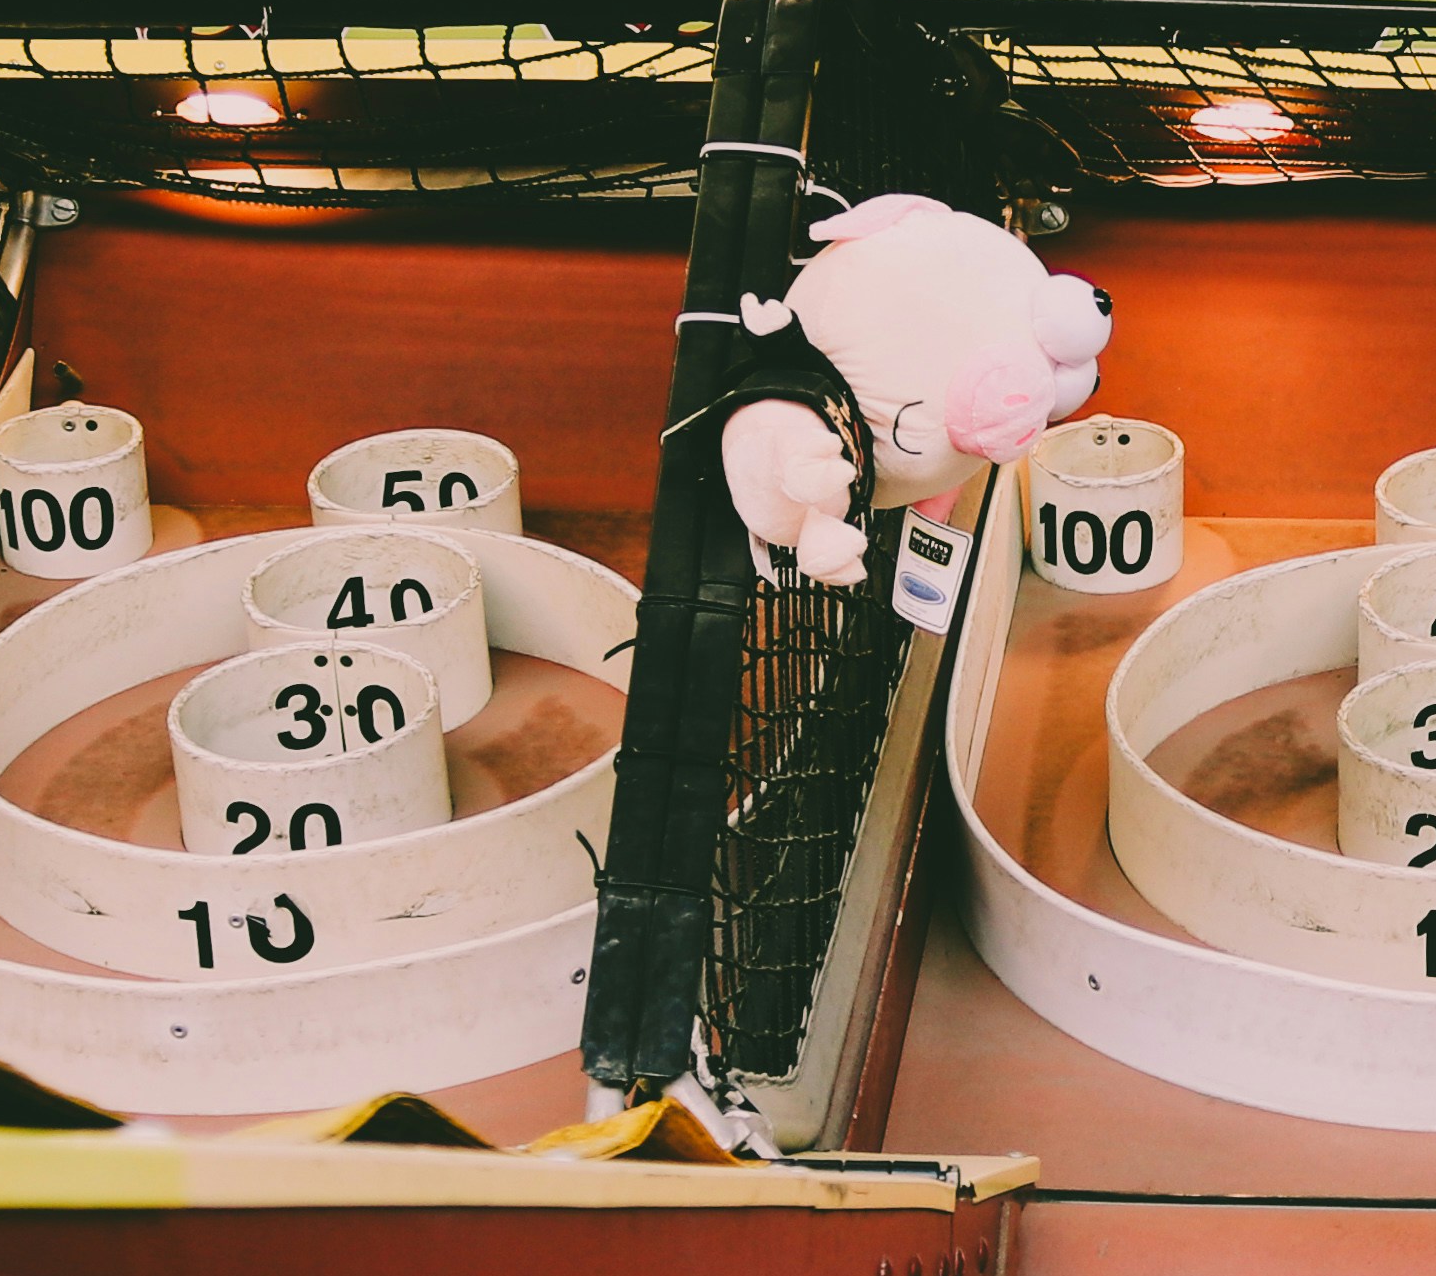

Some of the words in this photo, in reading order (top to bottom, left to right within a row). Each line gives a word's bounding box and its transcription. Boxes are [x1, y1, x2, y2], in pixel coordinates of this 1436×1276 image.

[0, 485, 116, 553] 100
[380, 469, 480, 514] 50
[1039, 501, 1154, 576] 100
[326, 576, 434, 630] 40
[273, 683, 407, 751] 30
[224, 801, 344, 857] 20
[177, 892, 316, 970] 10
